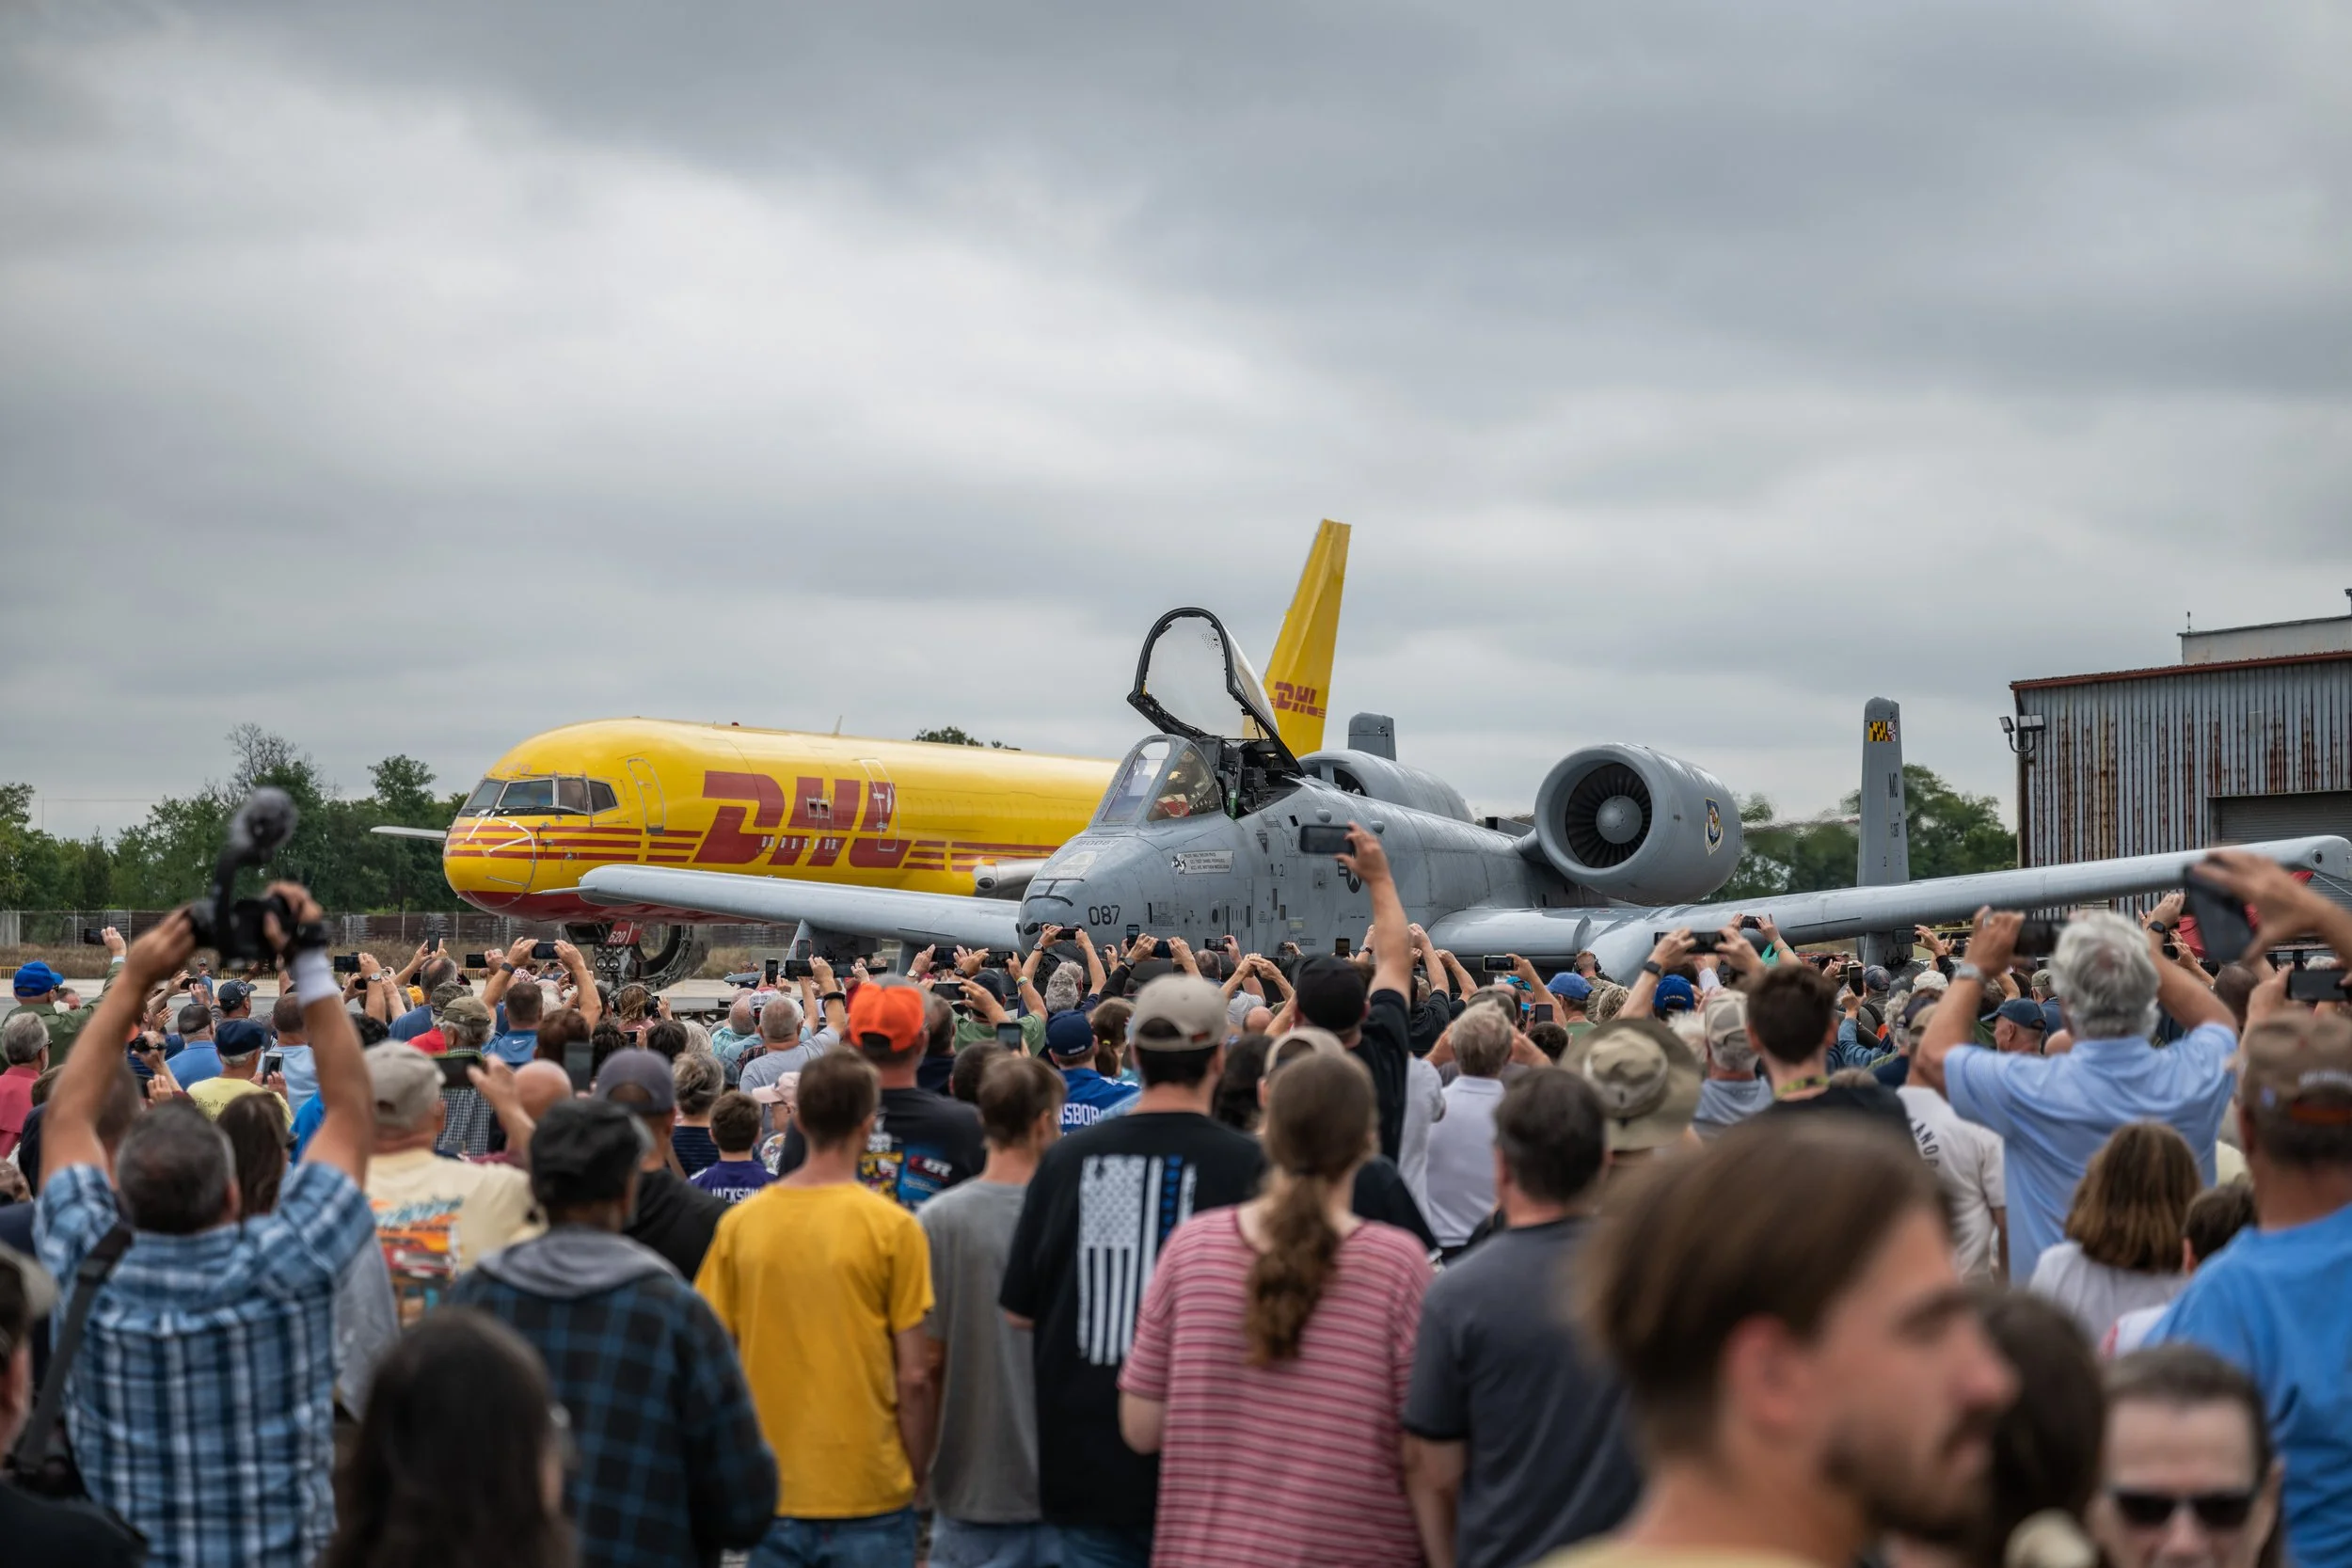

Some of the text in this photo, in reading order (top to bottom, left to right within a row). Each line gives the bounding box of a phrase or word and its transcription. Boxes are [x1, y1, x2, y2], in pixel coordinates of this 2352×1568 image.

[1275, 681, 1318, 717] DHL
[692, 770, 912, 869] DHL
[1089, 904, 1120, 926] 087
[608, 930, 627, 943] 620
